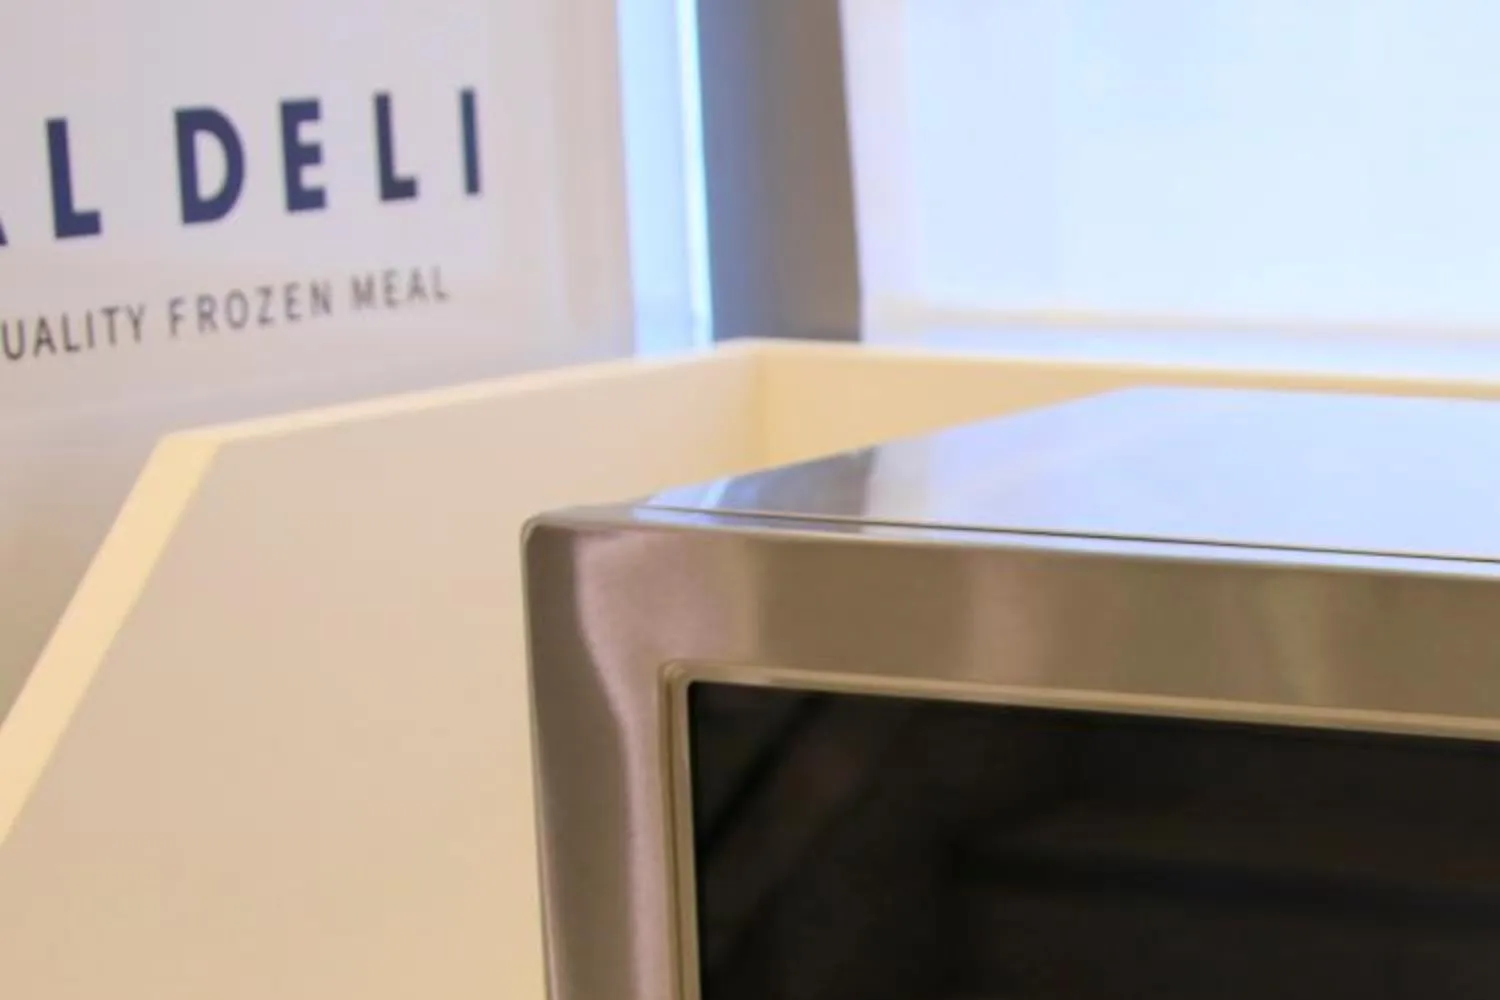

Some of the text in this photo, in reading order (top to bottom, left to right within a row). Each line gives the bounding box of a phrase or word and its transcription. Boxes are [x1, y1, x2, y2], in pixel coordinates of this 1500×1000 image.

[173, 87, 482, 226] DELI
[168, 281, 335, 338] FROZEN
[350, 265, 452, 310] MEAL
